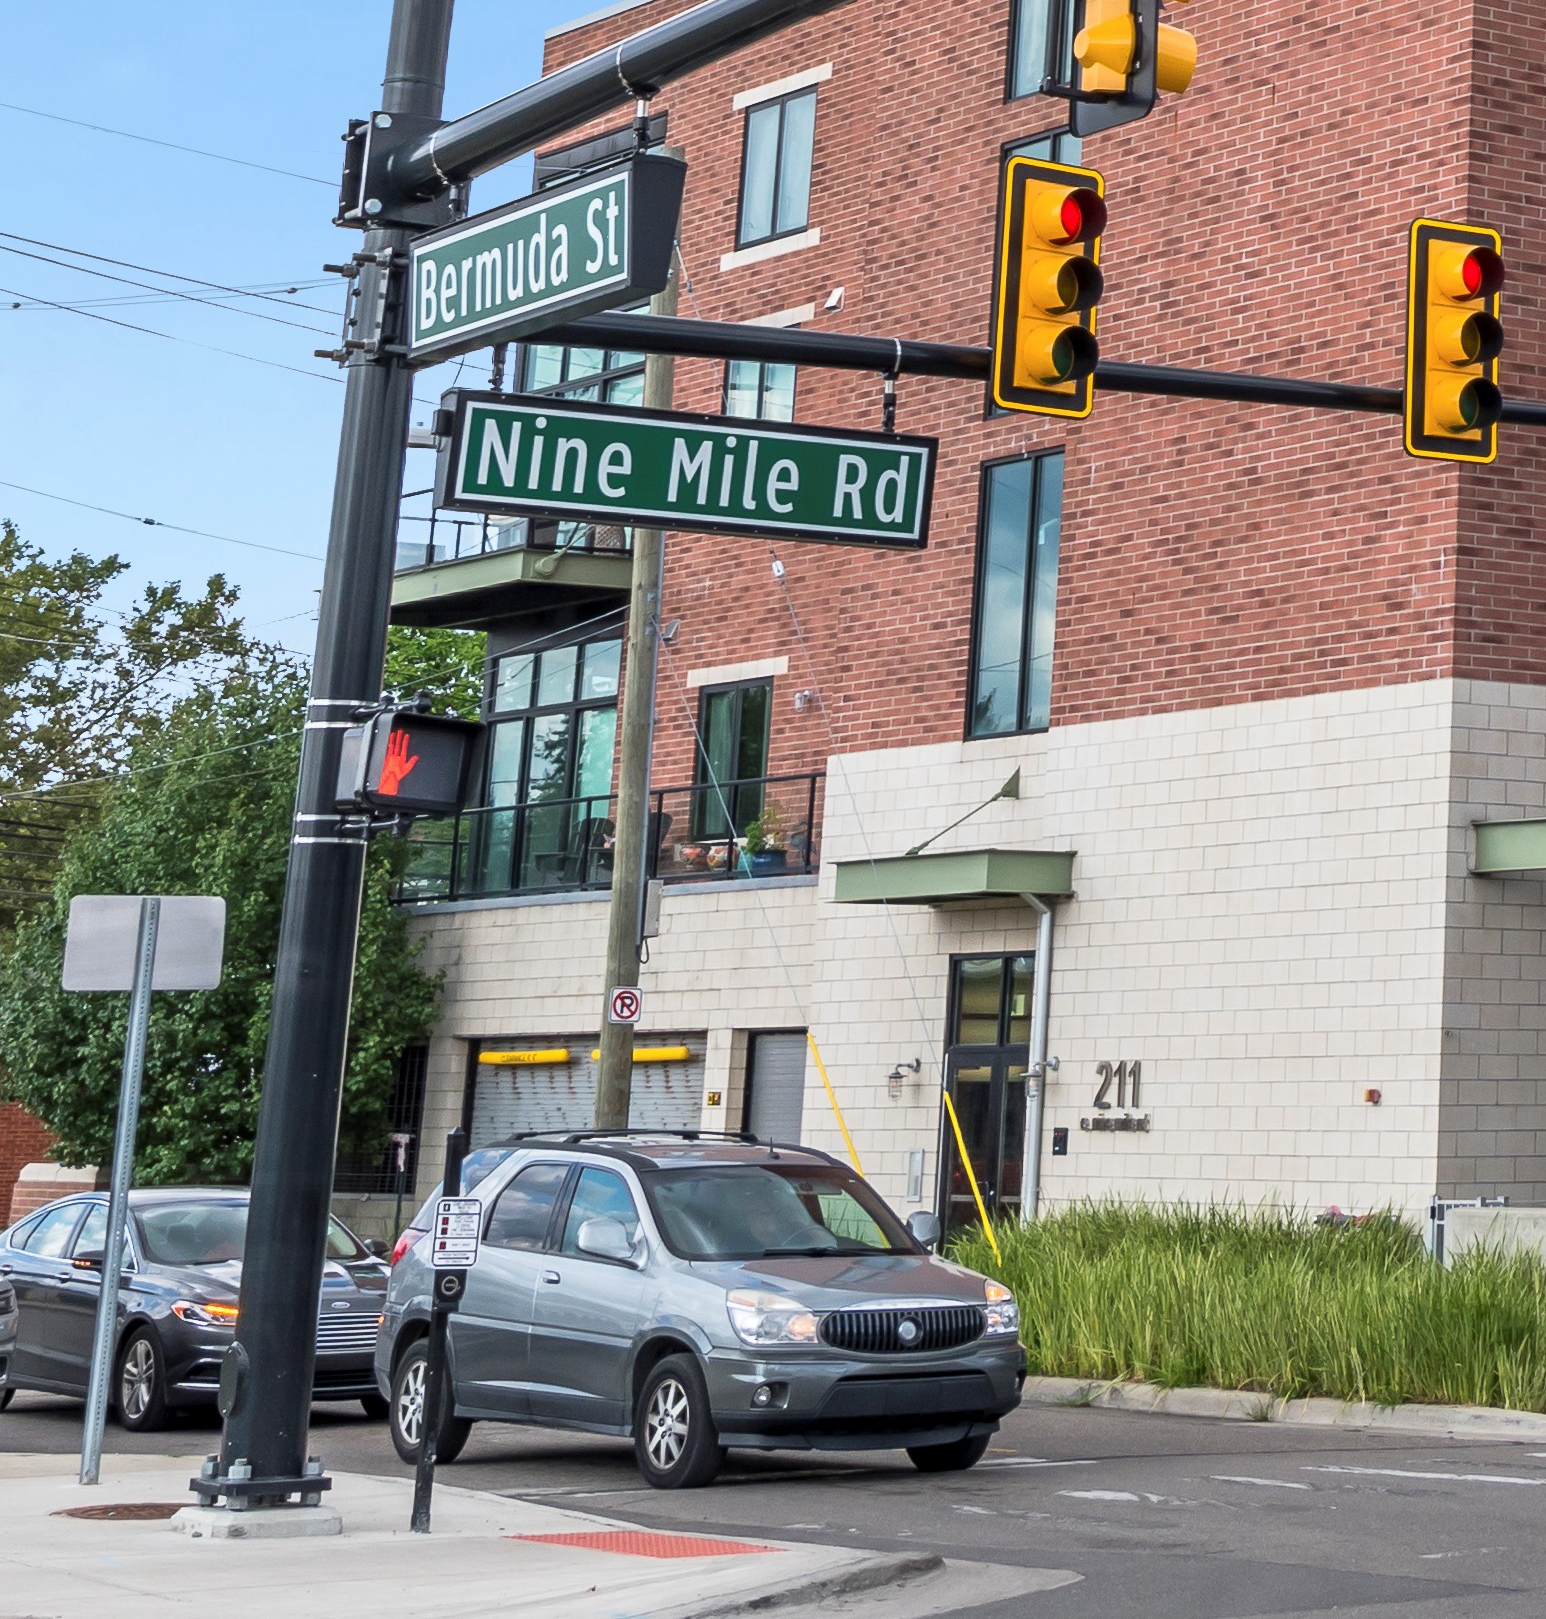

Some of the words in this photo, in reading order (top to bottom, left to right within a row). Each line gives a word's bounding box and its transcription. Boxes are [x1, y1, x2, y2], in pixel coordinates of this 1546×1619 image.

[420, 212, 569, 331] Bermuda
[585, 191, 619, 274] St
[477, 417, 632, 498] Nine
[667, 436, 800, 514] Mile
[833, 454, 910, 524] Rd
[1093, 1060, 1141, 1109] 211
